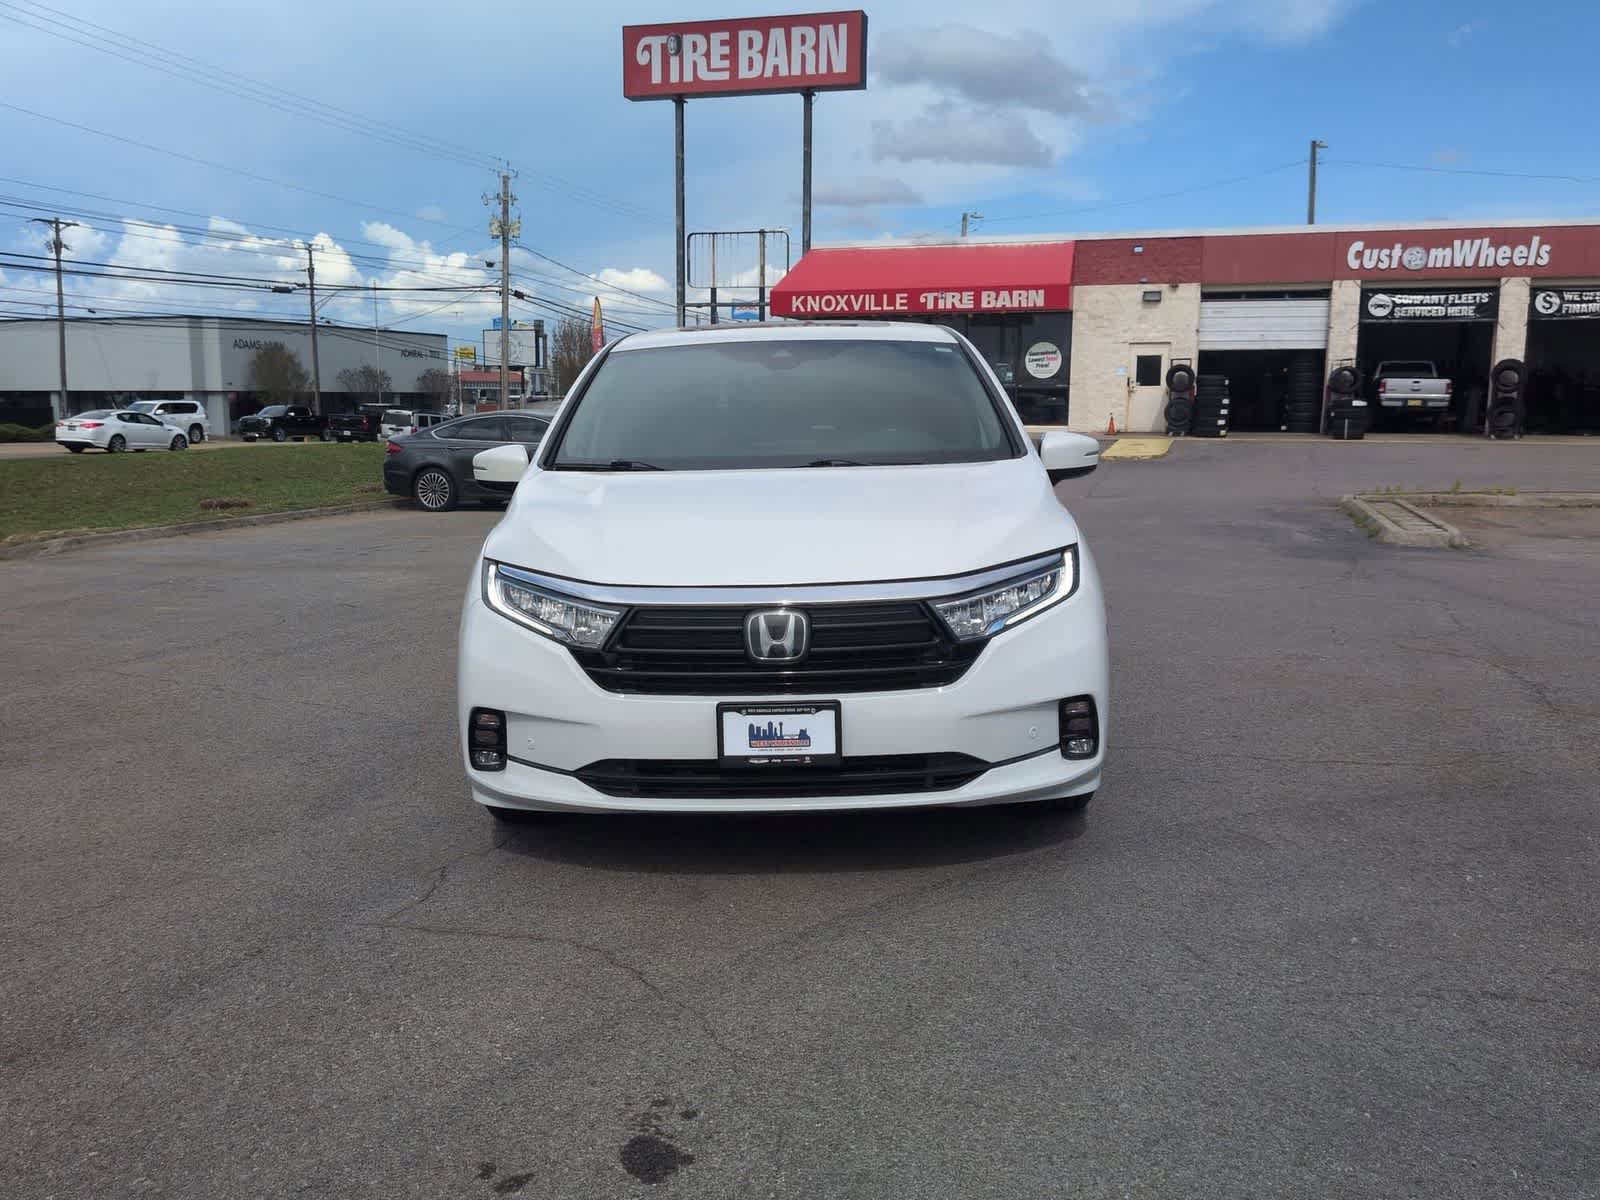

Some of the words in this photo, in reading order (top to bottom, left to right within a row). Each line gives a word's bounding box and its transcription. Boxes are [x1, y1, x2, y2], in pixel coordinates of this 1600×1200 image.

[738, 24, 848, 79] BARN
[791, 294, 908, 312] KNOXVILLE
[981, 290, 1045, 308] BARN
[1393, 294, 1447, 304] COMPANY
[1448, 292, 1489, 304] FLEETS
[1562, 291, 1581, 301] WE
[1394, 306, 1446, 318] SERVICED
[1447, 306, 1475, 317] HERE
